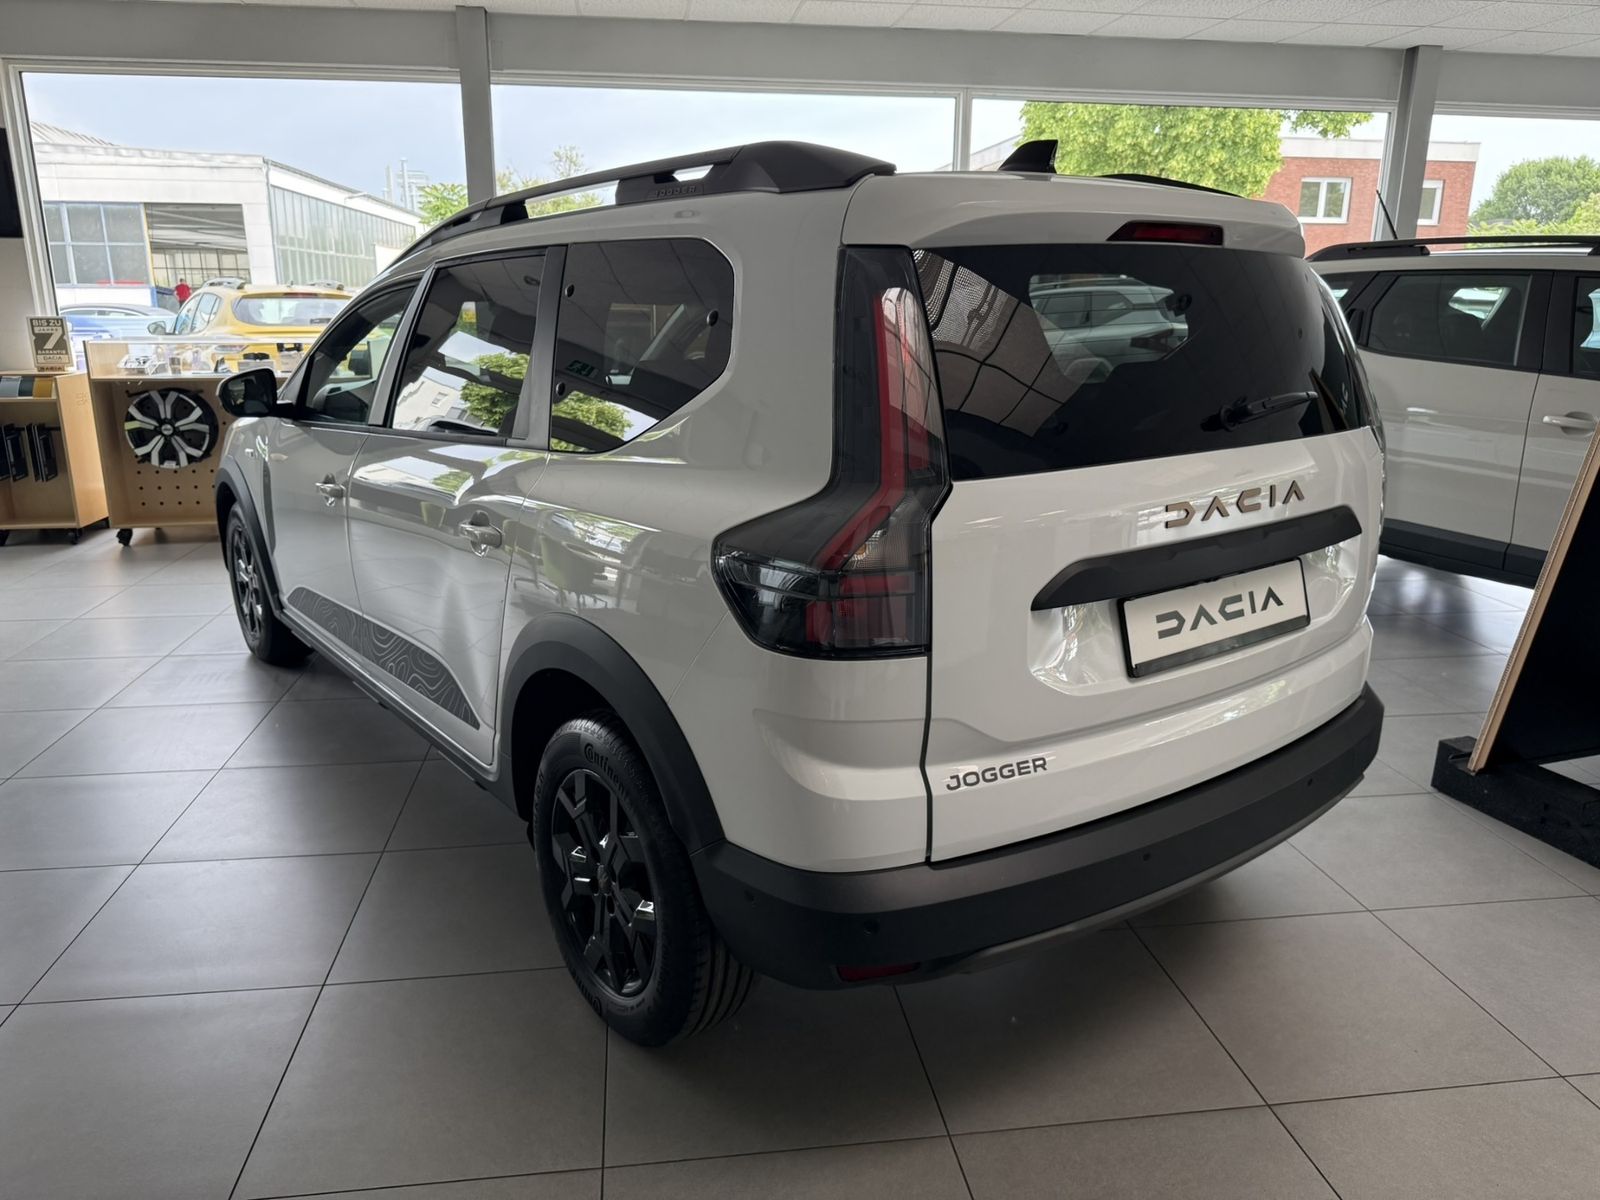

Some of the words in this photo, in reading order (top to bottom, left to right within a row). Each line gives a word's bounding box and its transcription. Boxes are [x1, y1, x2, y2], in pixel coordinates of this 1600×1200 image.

[33, 326, 63, 349] 7
[1165, 480, 1305, 529] DACIA
[1155, 586, 1284, 640] DACIA
[946, 757, 1048, 791] JOGGER
